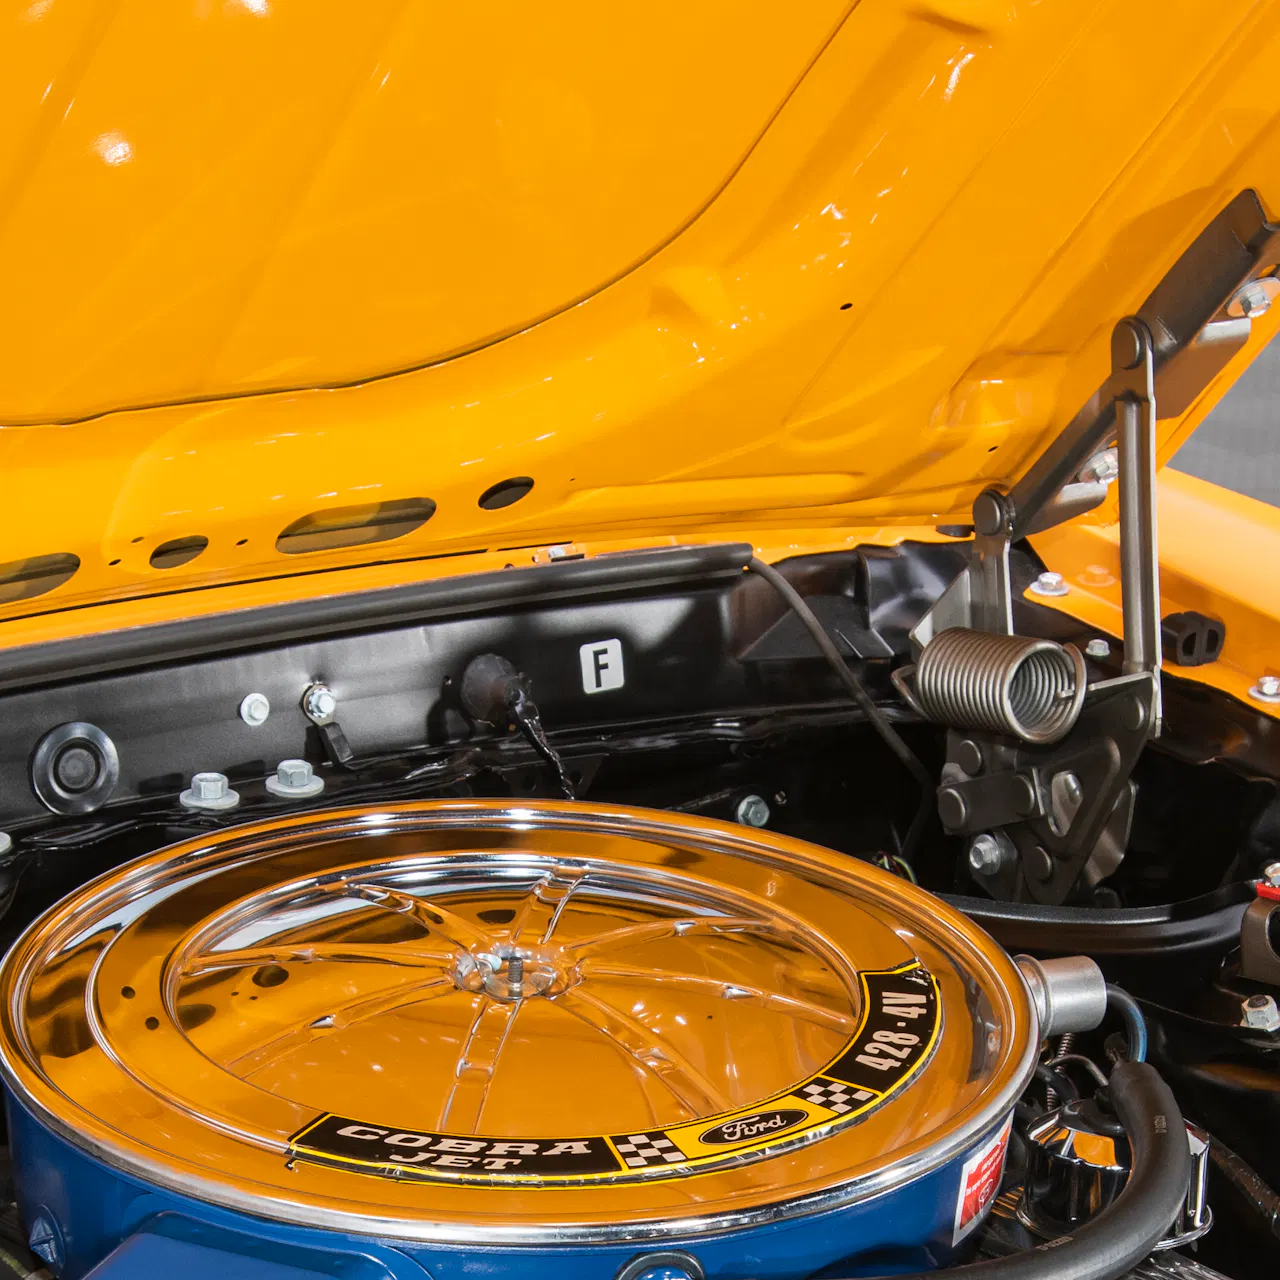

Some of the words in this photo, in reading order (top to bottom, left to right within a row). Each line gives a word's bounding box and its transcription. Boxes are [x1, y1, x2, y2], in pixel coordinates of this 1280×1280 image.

[592, 648, 609, 688] F
[855, 1030, 920, 1074] 428
[334, 1125, 592, 1156] COBRA
[721, 1113, 786, 1142] Ford
[388, 1152, 523, 1171] JET
